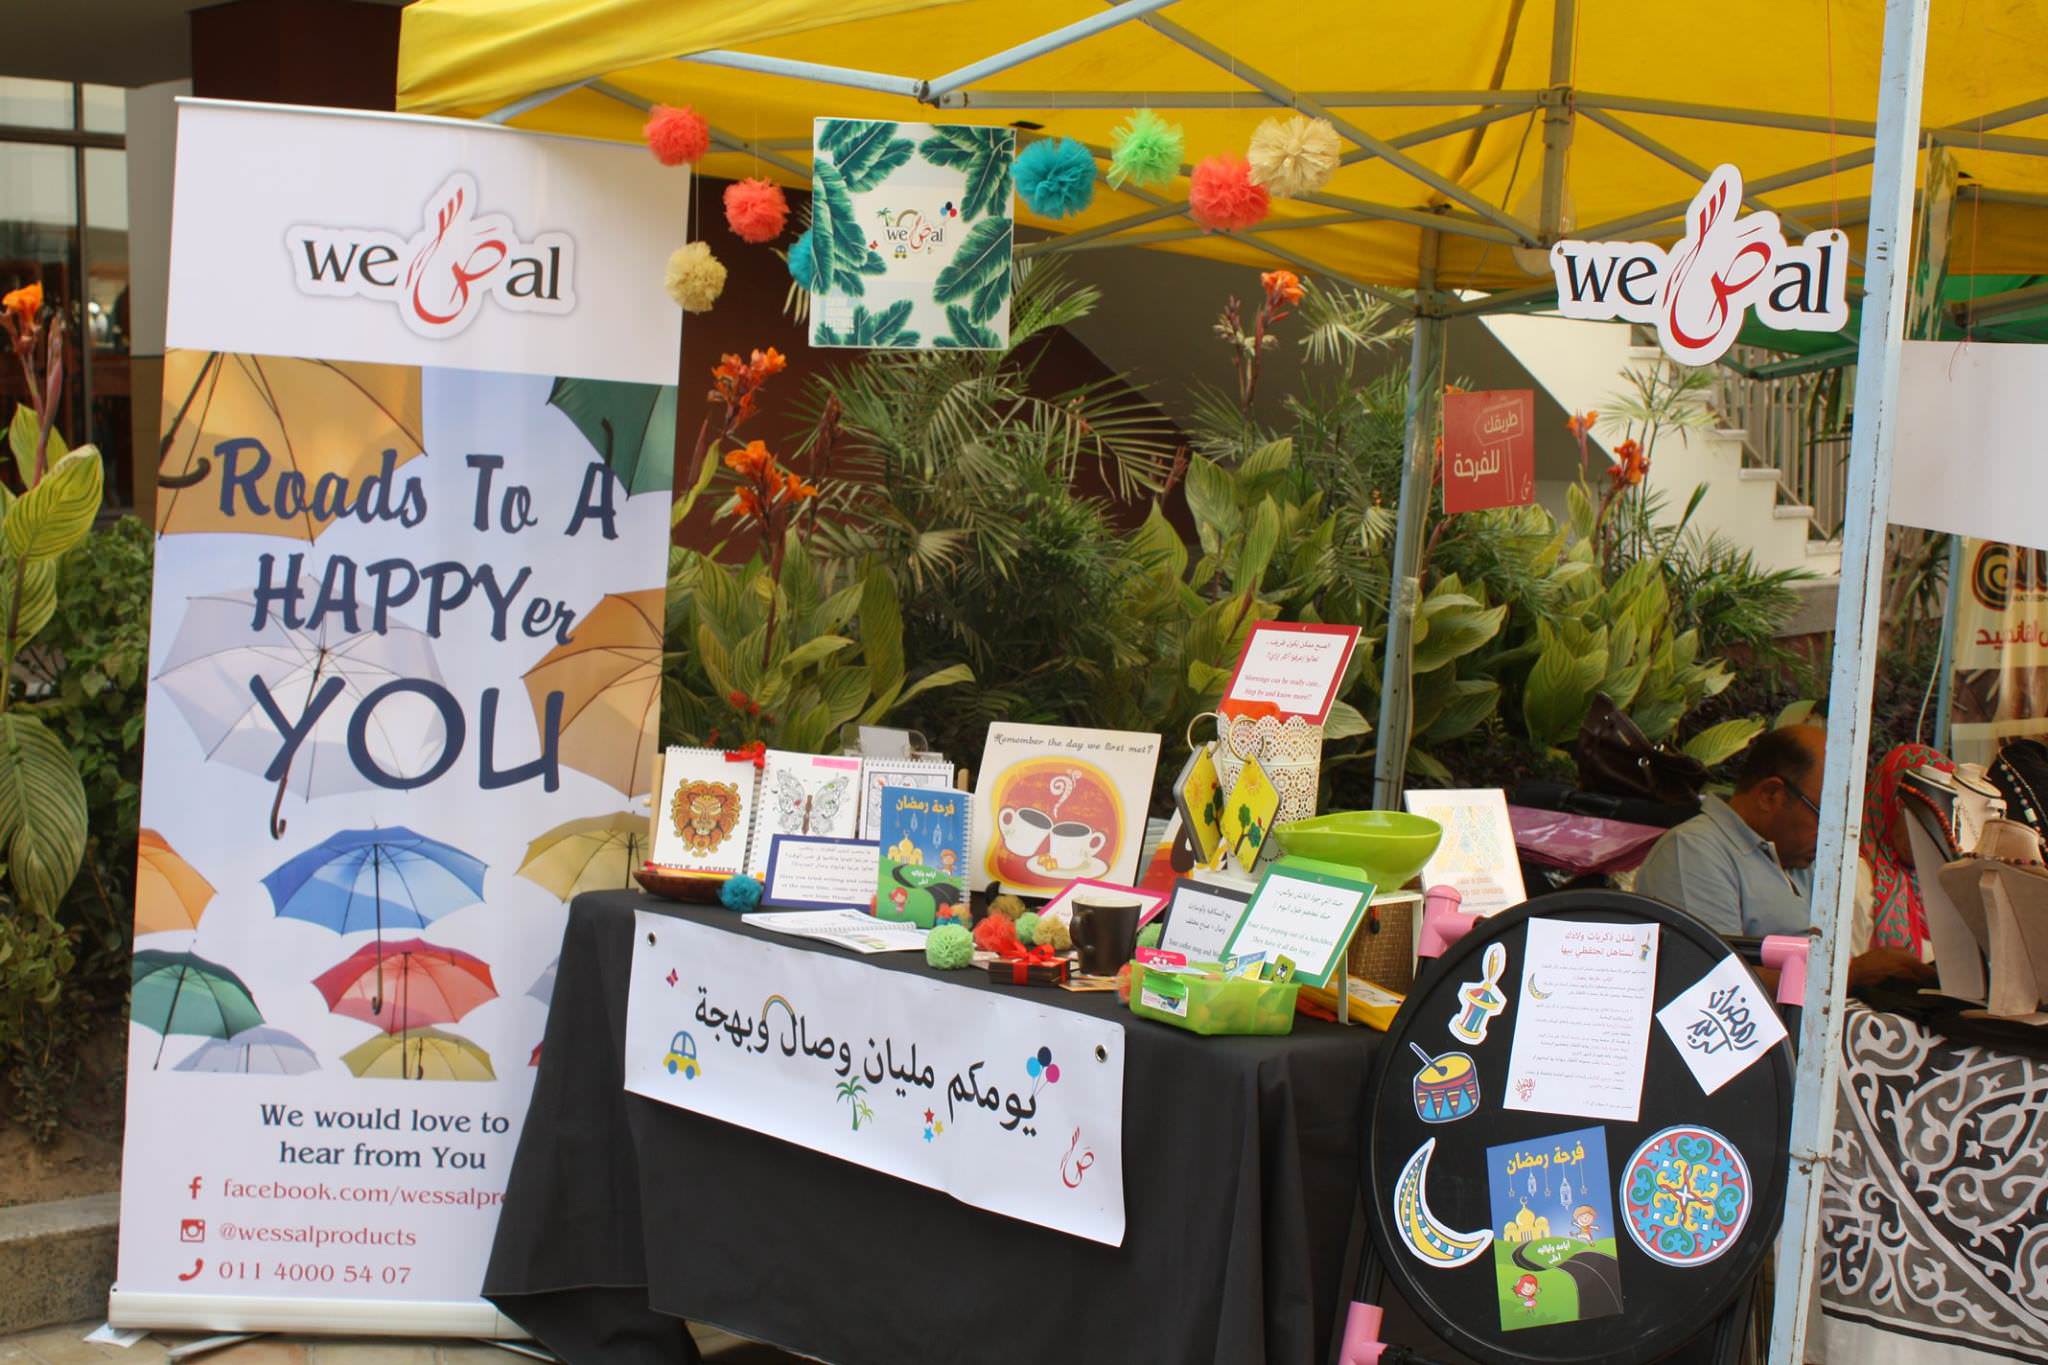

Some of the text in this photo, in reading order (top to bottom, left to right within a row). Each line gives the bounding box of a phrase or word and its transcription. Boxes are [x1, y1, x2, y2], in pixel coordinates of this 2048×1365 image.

[1454, 449, 1500, 482] للفرحة
[214, 437, 619, 540] Roads To A
[249, 674, 564, 793] YOU
[1048, 736, 1061, 747] the
[1066, 738, 1083, 750] day
[695, 985, 1037, 1137] يومكم مليان وصال وبهجة
[260, 1104, 510, 1134] We would love to
[279, 1141, 487, 1170] hear from You
[1506, 1140, 1585, 1175] فرحة رمضان
[219, 1222, 417, 1248] @wessalproducts
[218, 1262, 412, 1285] 011 4000 54 07
